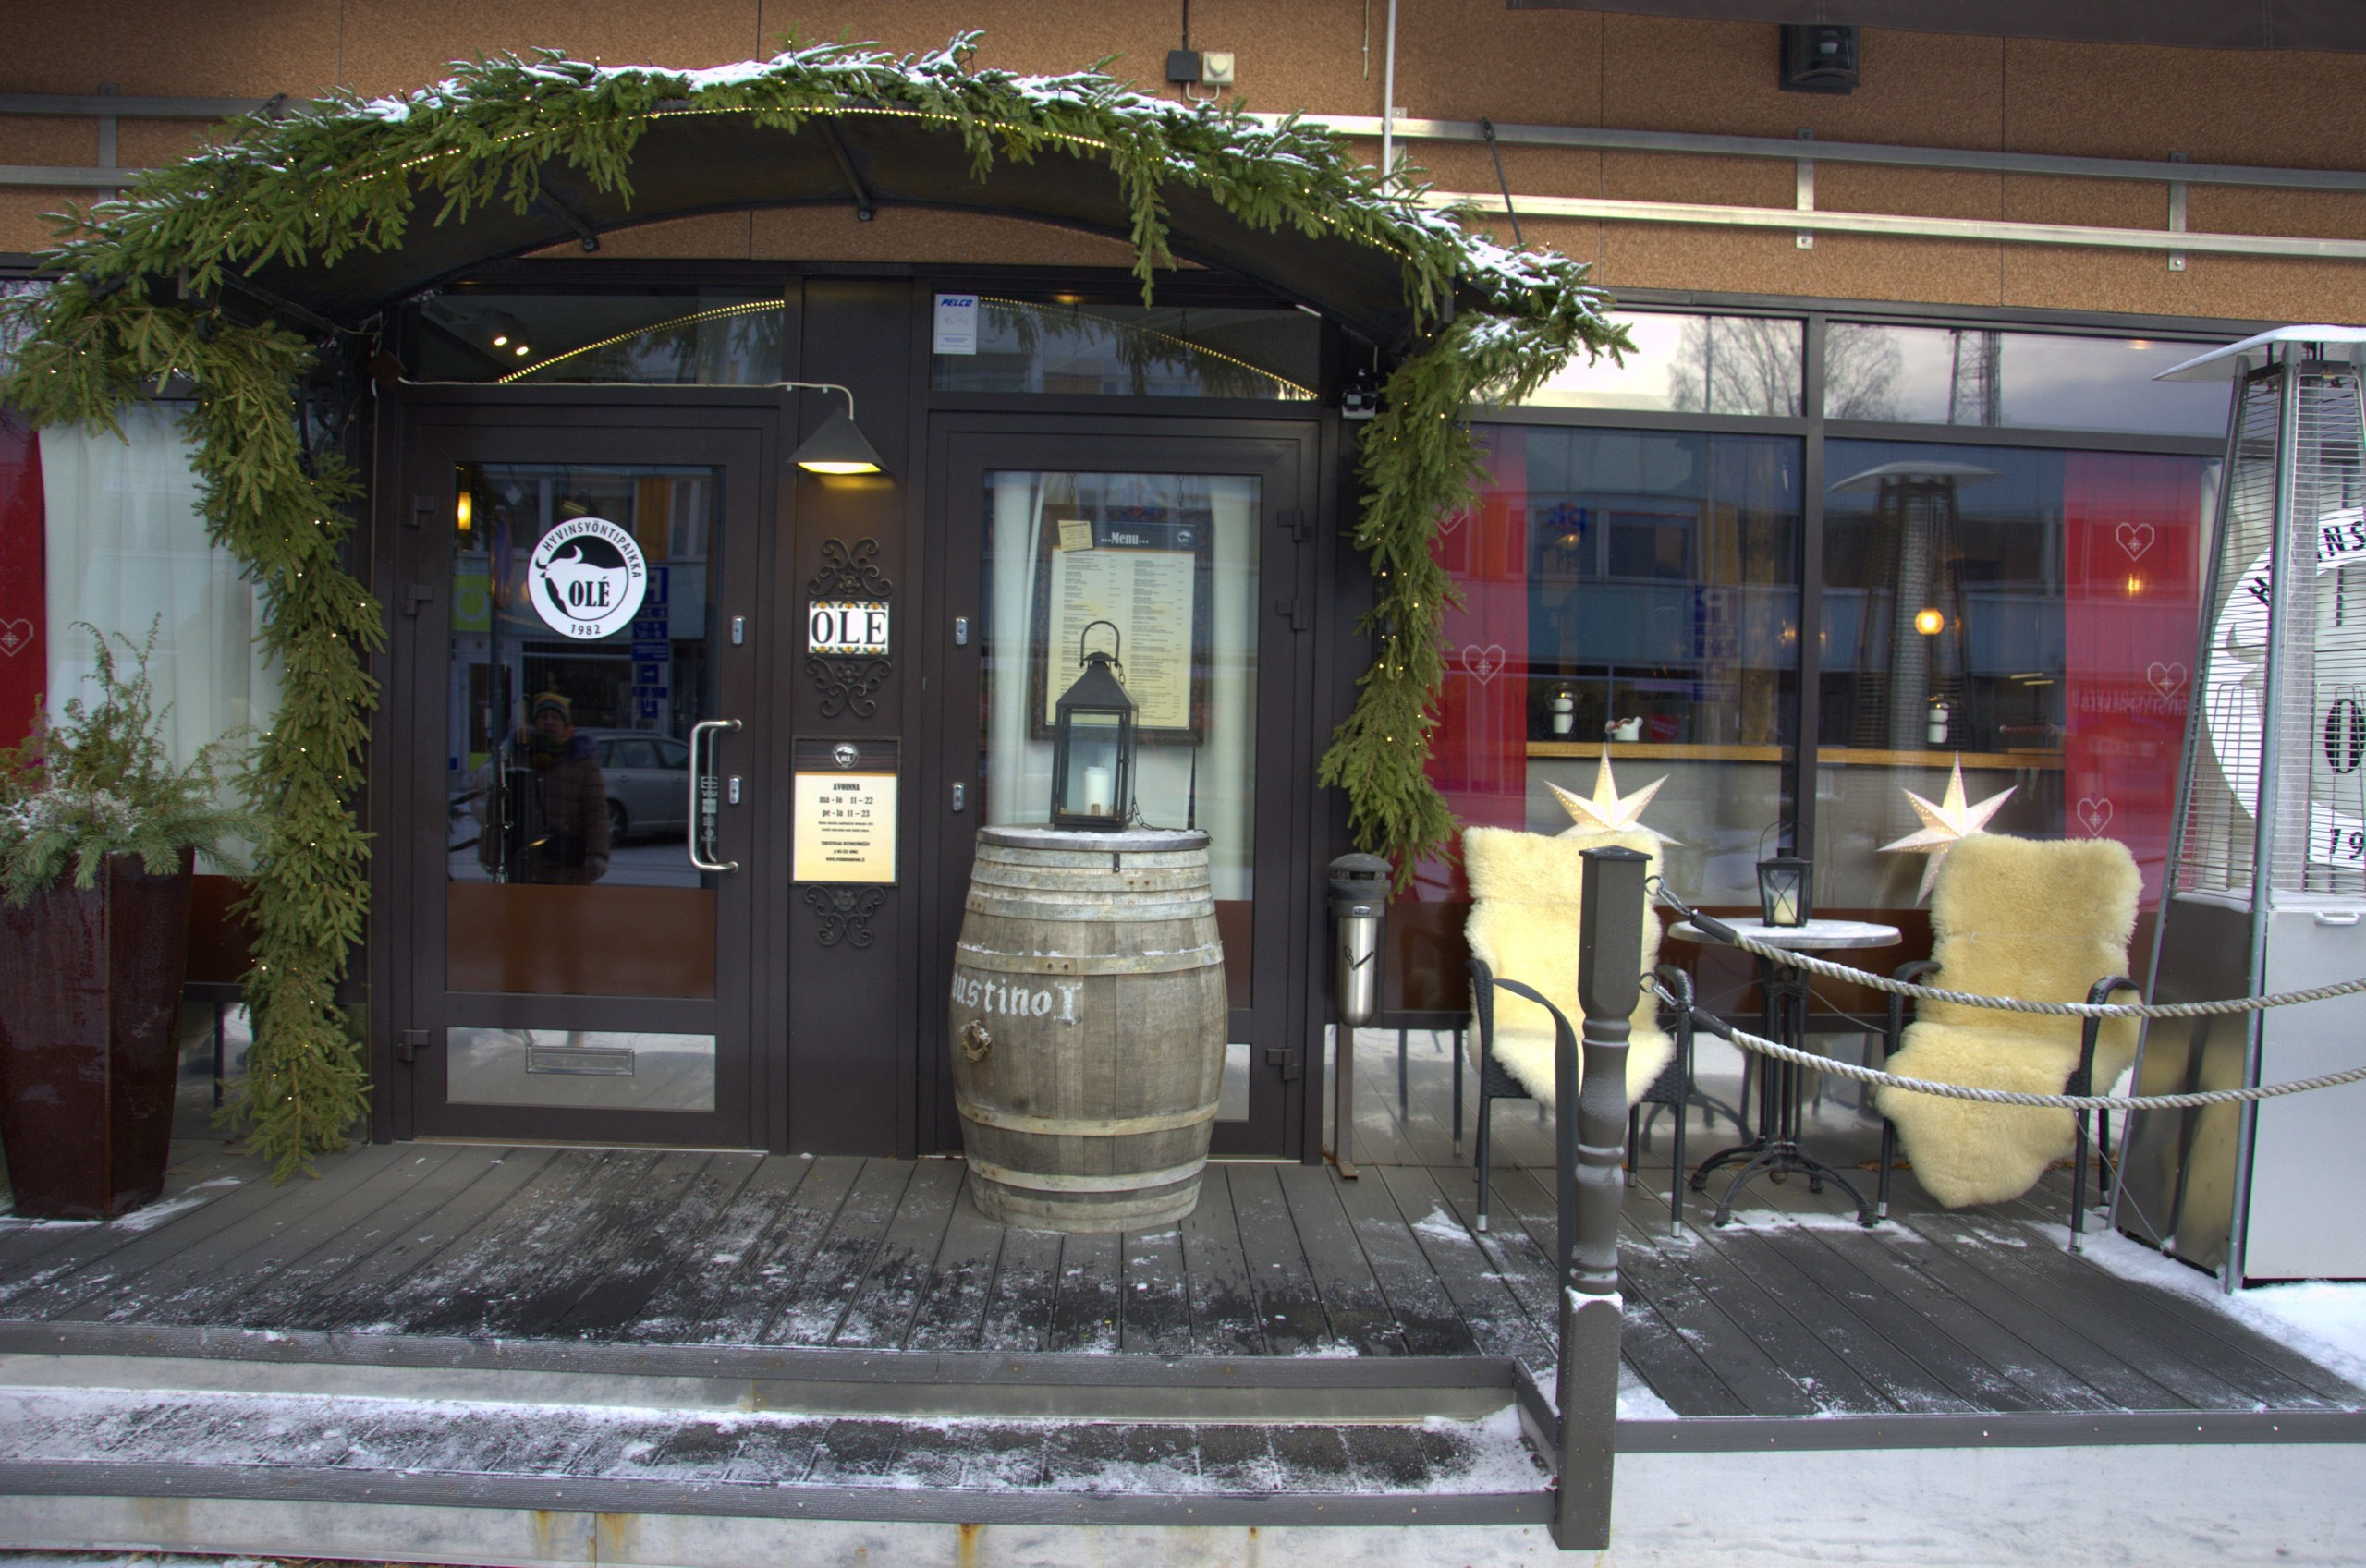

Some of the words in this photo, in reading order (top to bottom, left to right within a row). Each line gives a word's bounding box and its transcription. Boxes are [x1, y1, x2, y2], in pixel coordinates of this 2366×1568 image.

[941, 298, 972, 307] PELCO
[543, 520, 642, 578] HYVINSYÖNTIPAIKKA
[568, 576, 610, 607] OLÉ
[571, 624, 601, 635] 1982
[811, 611, 886, 645] OLE
[833, 783, 860, 791] AVOINNA
[865, 796, 873, 805] 22
